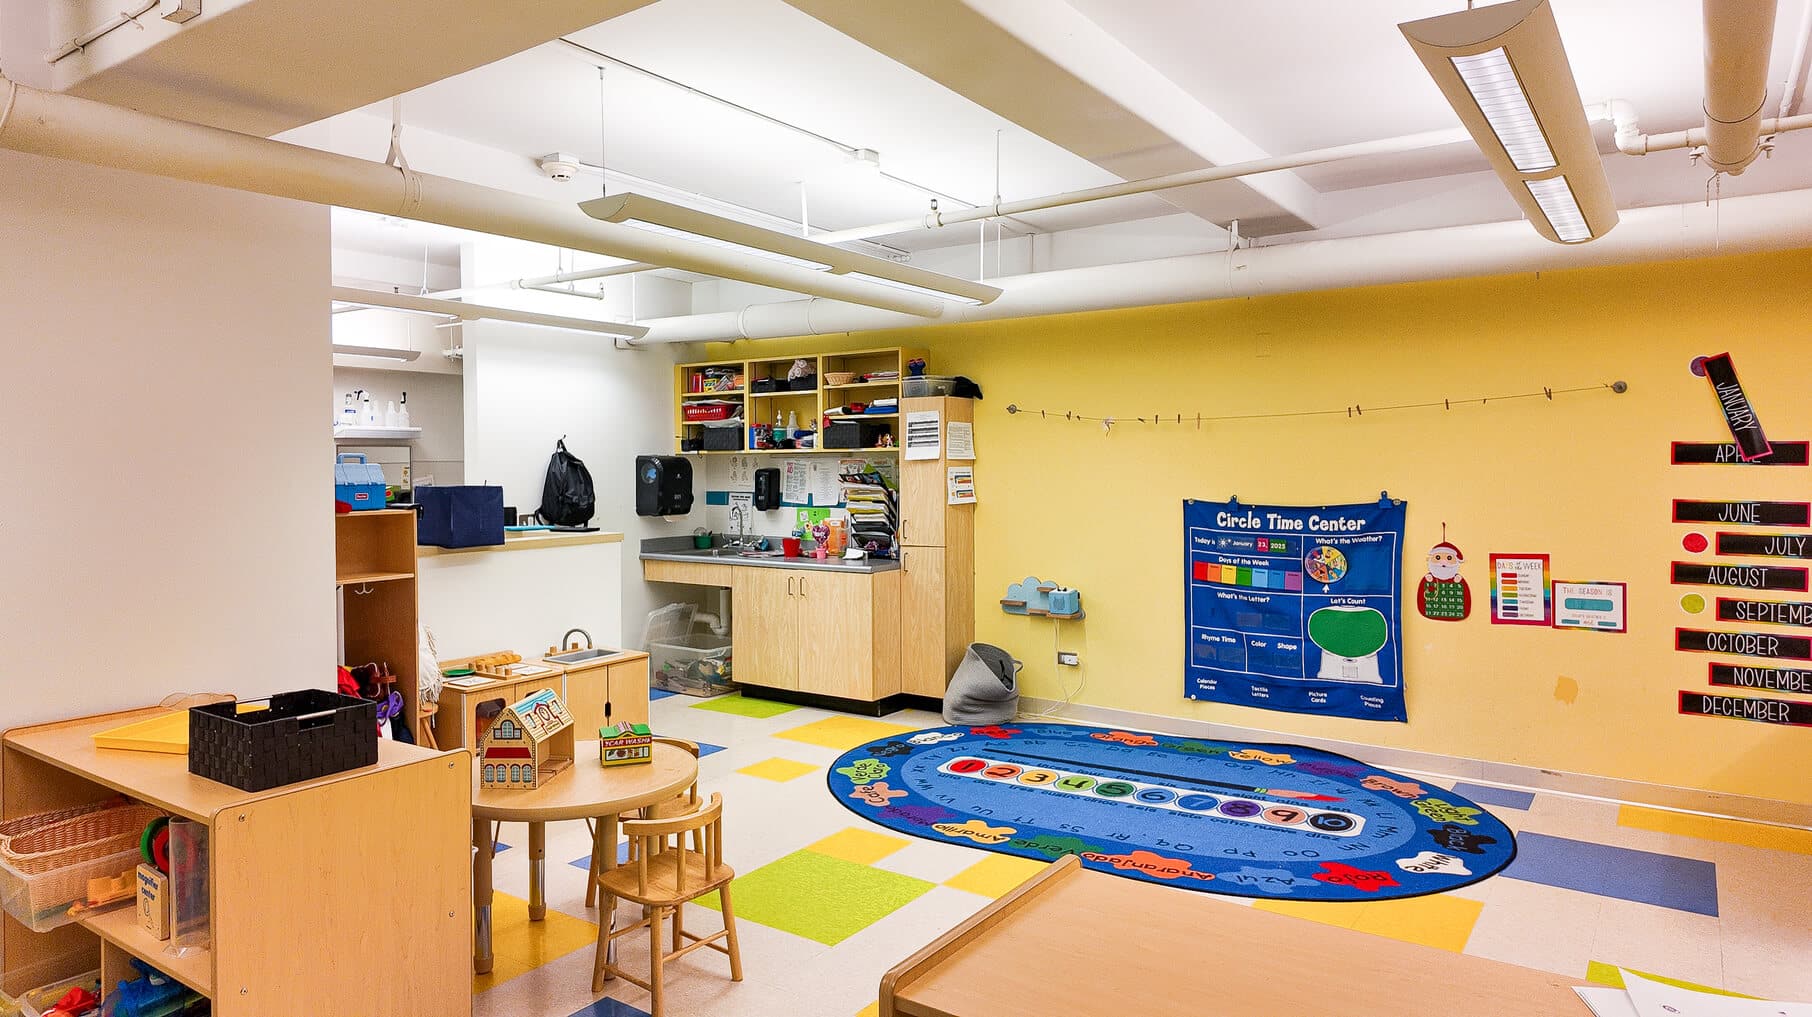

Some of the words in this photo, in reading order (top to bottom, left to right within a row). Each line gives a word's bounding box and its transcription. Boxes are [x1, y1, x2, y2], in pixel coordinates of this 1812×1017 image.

[1716, 382, 1757, 431] JANUARY
[1715, 444, 1761, 463] APR
[1216, 511, 1261, 529] Circle
[1266, 513, 1303, 530] Time
[1308, 515, 1366, 531] Center
[1718, 503, 1760, 523] JUNE
[1194, 537, 1211, 545] Today
[1316, 537, 1338, 545] What's
[1352, 536, 1383, 544] Weather?
[1764, 537, 1807, 556] JULY
[1219, 557, 1232, 565] Days
[1523, 562, 1541, 571] WEEK
[1707, 566, 1768, 588] AUGUST
[1217, 592, 1238, 600] What's
[1736, 601, 1812, 625] SEPTEMB
[1201, 634, 1220, 643] Rhyme
[1222, 636, 1237, 644] Time
[1251, 640, 1268, 648] Color
[1277, 643, 1298, 651] Shape
[1707, 632, 1779, 656] OCTOBER
[1733, 667, 1812, 693] NOVEMBE
[1702, 695, 1790, 723] DECEMBER
[609, 739, 625, 747] CAR
[1097, 733, 1158, 746] Orange
[1230, 751, 1293, 764] Yellow
[853, 763, 873, 782] Verde
[988, 767, 1015, 778] 2
[1025, 773, 1049, 783] 3
[1063, 779, 1089, 789] 4
[1105, 784, 1128, 795] 5
[1141, 791, 1166, 801] 6
[1191, 798, 1212, 807] 7
[1227, 803, 1255, 815] 8
[1272, 810, 1299, 822] 9
[1317, 816, 1348, 828] 10
[1363, 778, 1418, 799] Brown
[935, 824, 1005, 842] Amarillo
[1015, 839, 1074, 854] Verde
[1083, 853, 1213, 880] Anaranjado
[1405, 854, 1453, 873] White
[1236, 875, 1295, 886] Azul
[1328, 873, 1387, 885] Rojo
[142, 887, 156, 901] center
